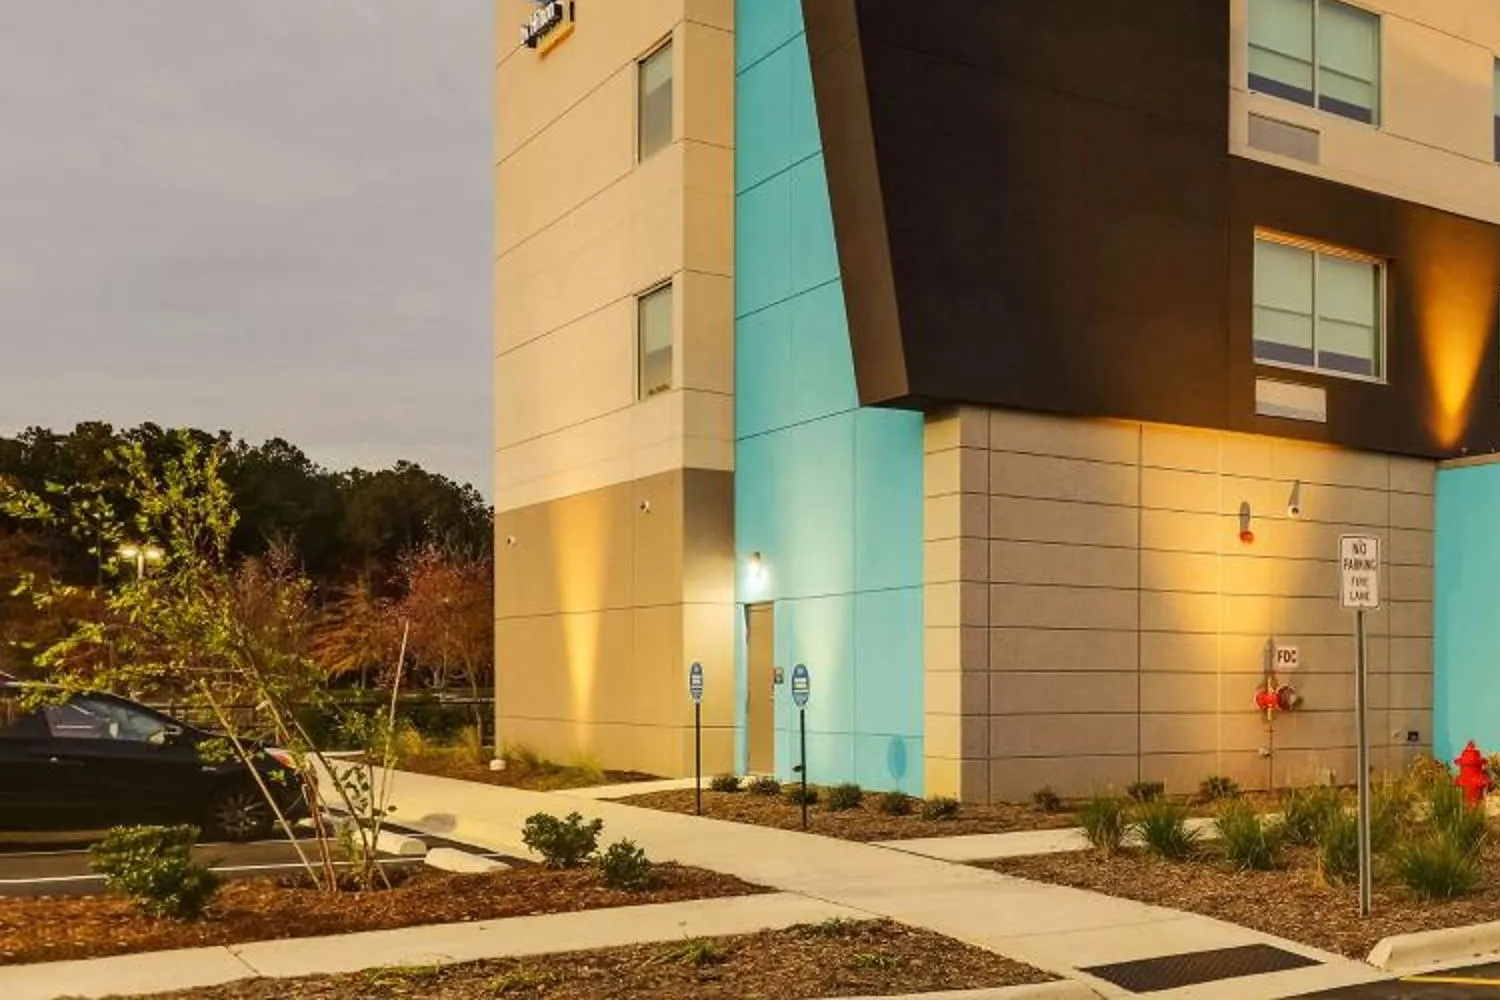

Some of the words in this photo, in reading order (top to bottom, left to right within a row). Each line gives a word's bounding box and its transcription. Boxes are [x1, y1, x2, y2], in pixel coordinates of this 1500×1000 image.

[1353, 543, 1367, 555] NO
[1343, 558, 1377, 570] PARKING
[1277, 649, 1297, 663] FDC
